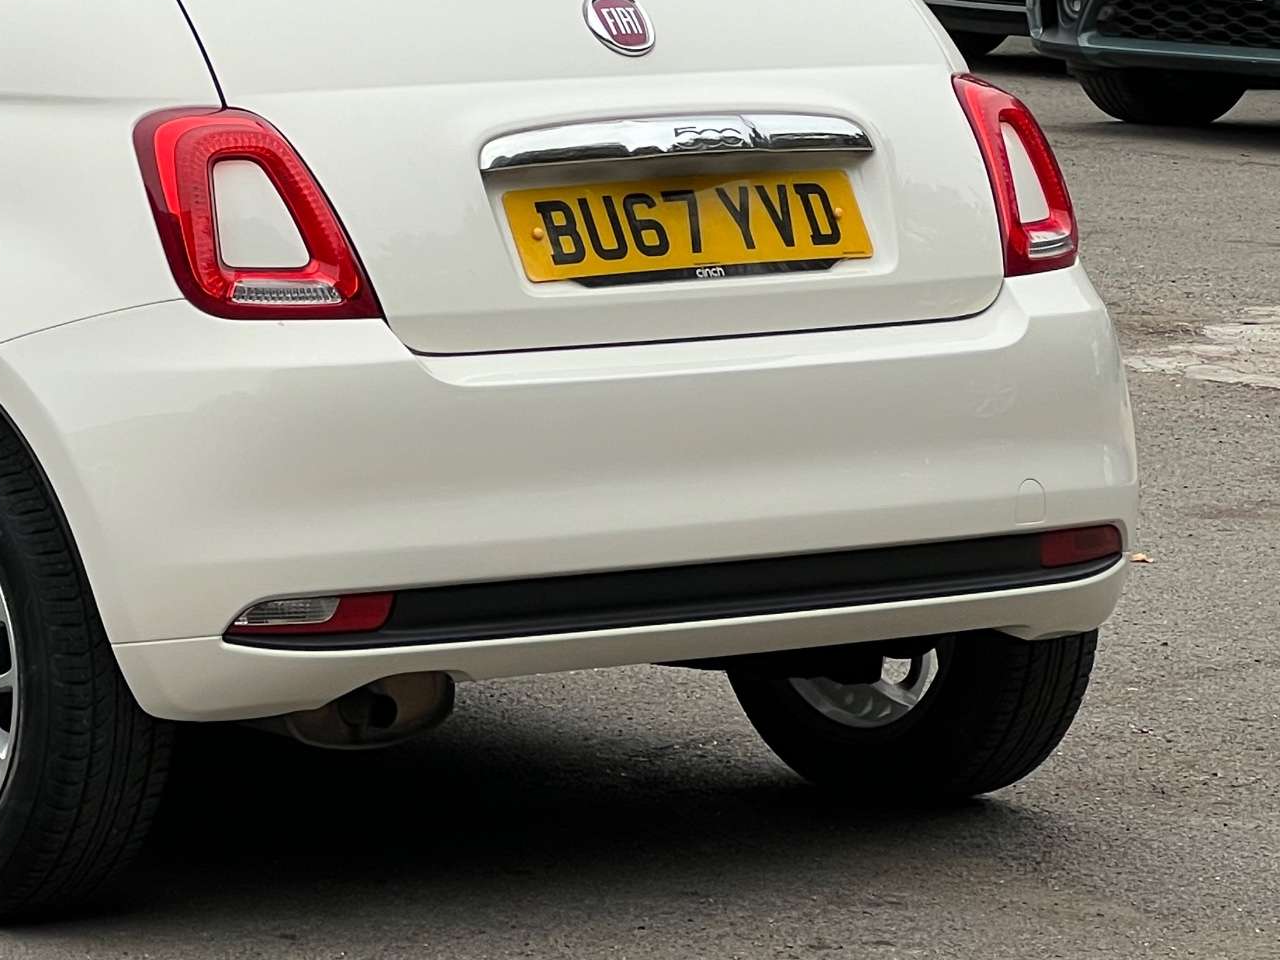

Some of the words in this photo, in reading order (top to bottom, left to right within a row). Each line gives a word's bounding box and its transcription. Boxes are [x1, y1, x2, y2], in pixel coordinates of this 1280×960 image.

[601, 5, 643, 36] FIAT
[673, 126, 744, 149] 500
[534, 190, 704, 266] BU67
[715, 182, 842, 250] YVD
[695, 266, 726, 278] cinch
